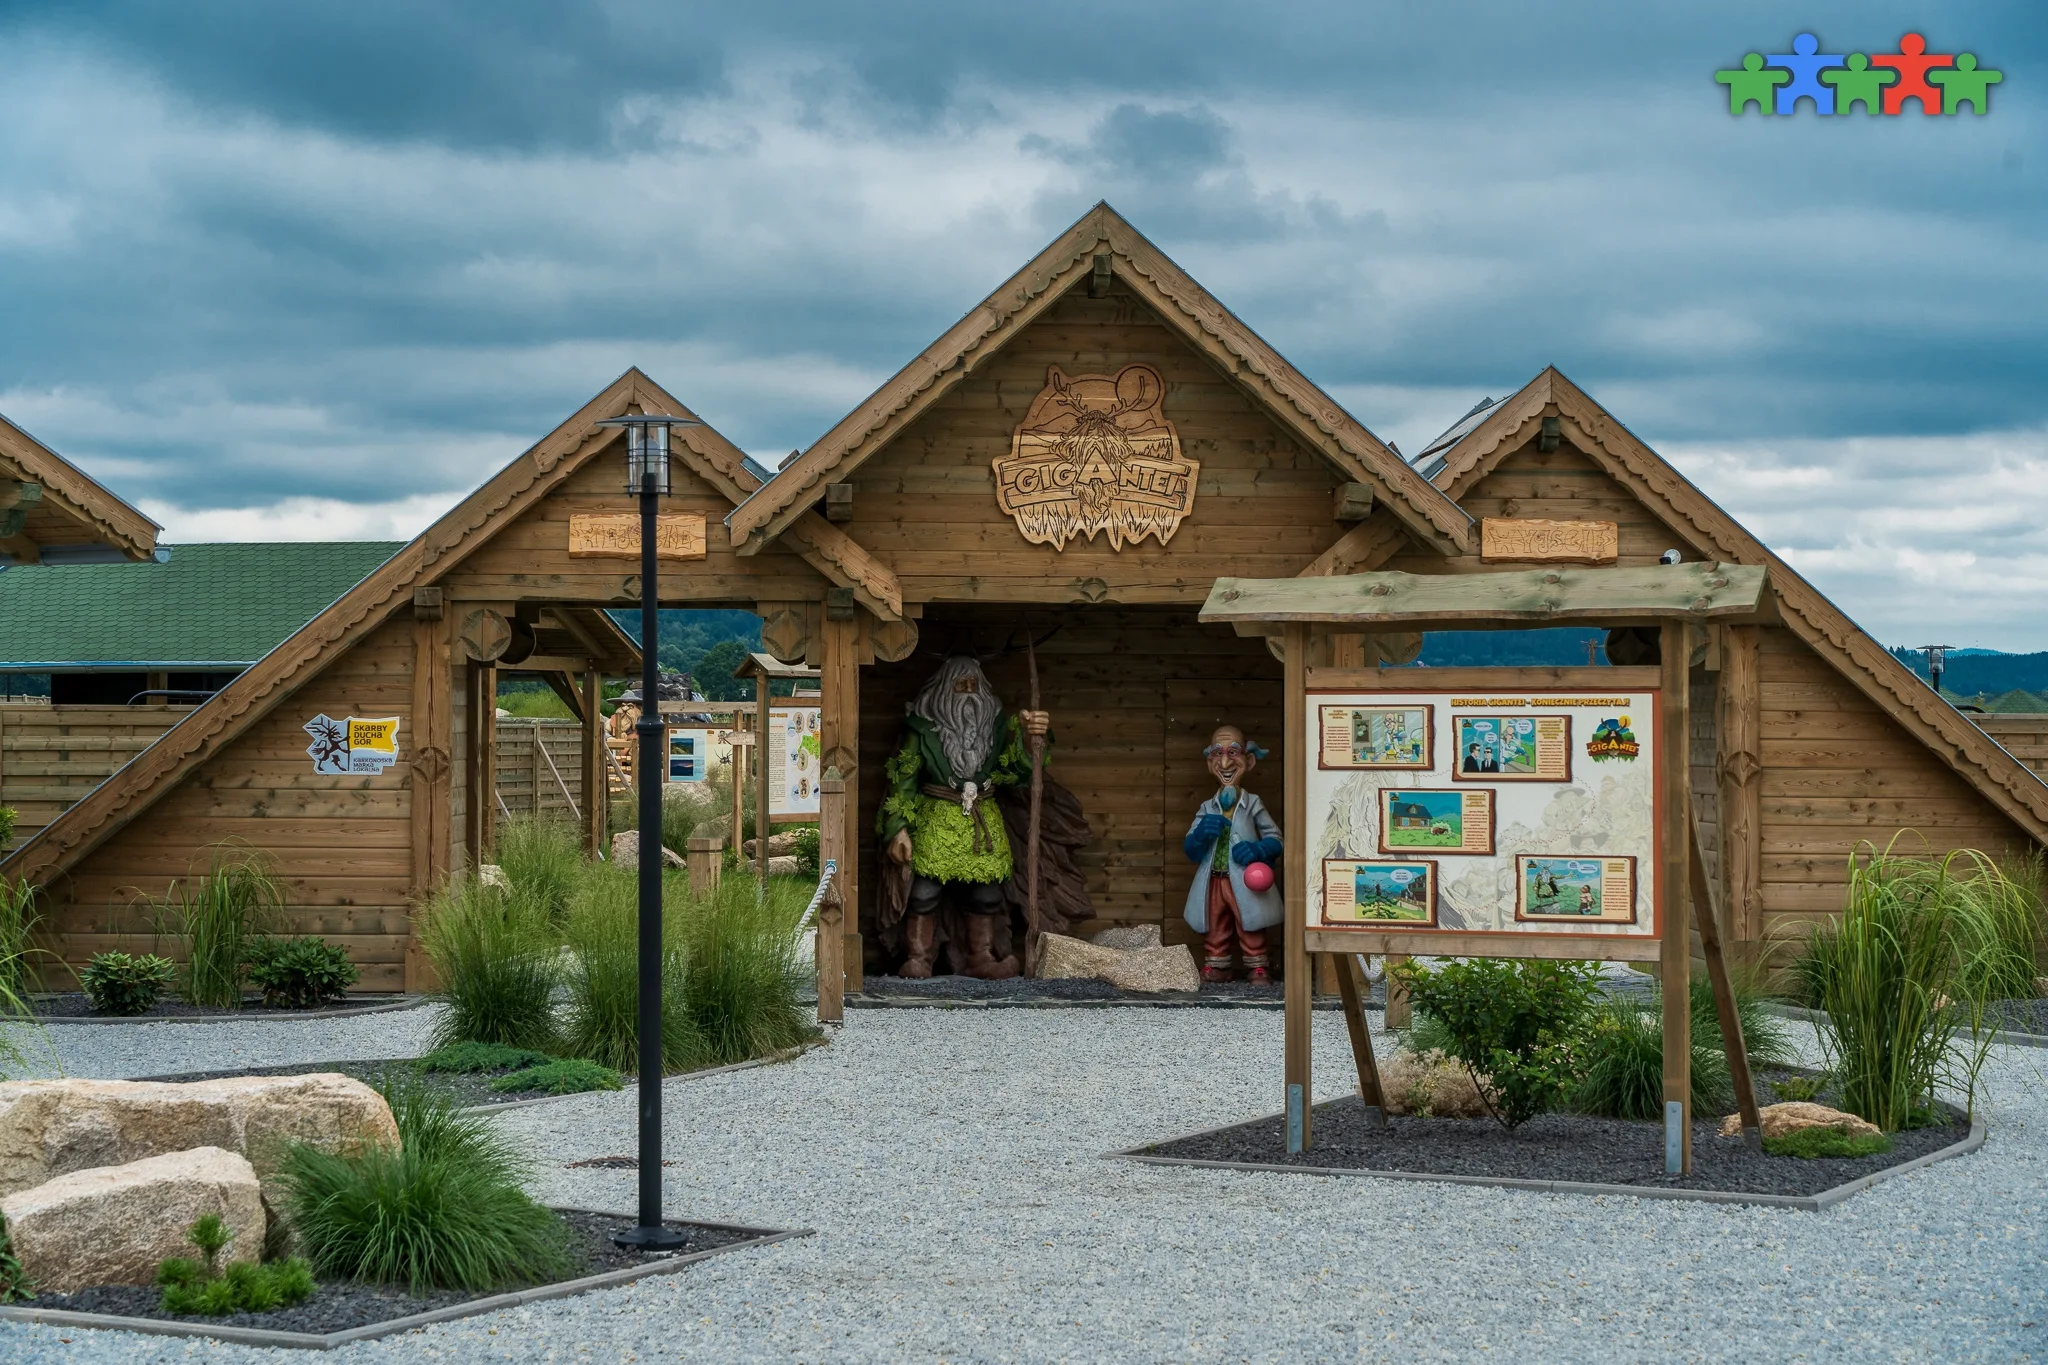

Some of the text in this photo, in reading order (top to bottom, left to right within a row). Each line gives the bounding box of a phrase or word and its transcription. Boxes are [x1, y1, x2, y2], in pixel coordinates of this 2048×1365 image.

[1014, 446, 1180, 497] GIGANTEI
[1451, 698, 1486, 707] HISTORIA
[1488, 698, 1526, 707] GIGANTEI
[1531, 698, 1577, 707] KONIECZNIE
[1578, 698, 1630, 707] PRZECZYTAJ!
[1590, 739, 1637, 753] GIGANTEI
